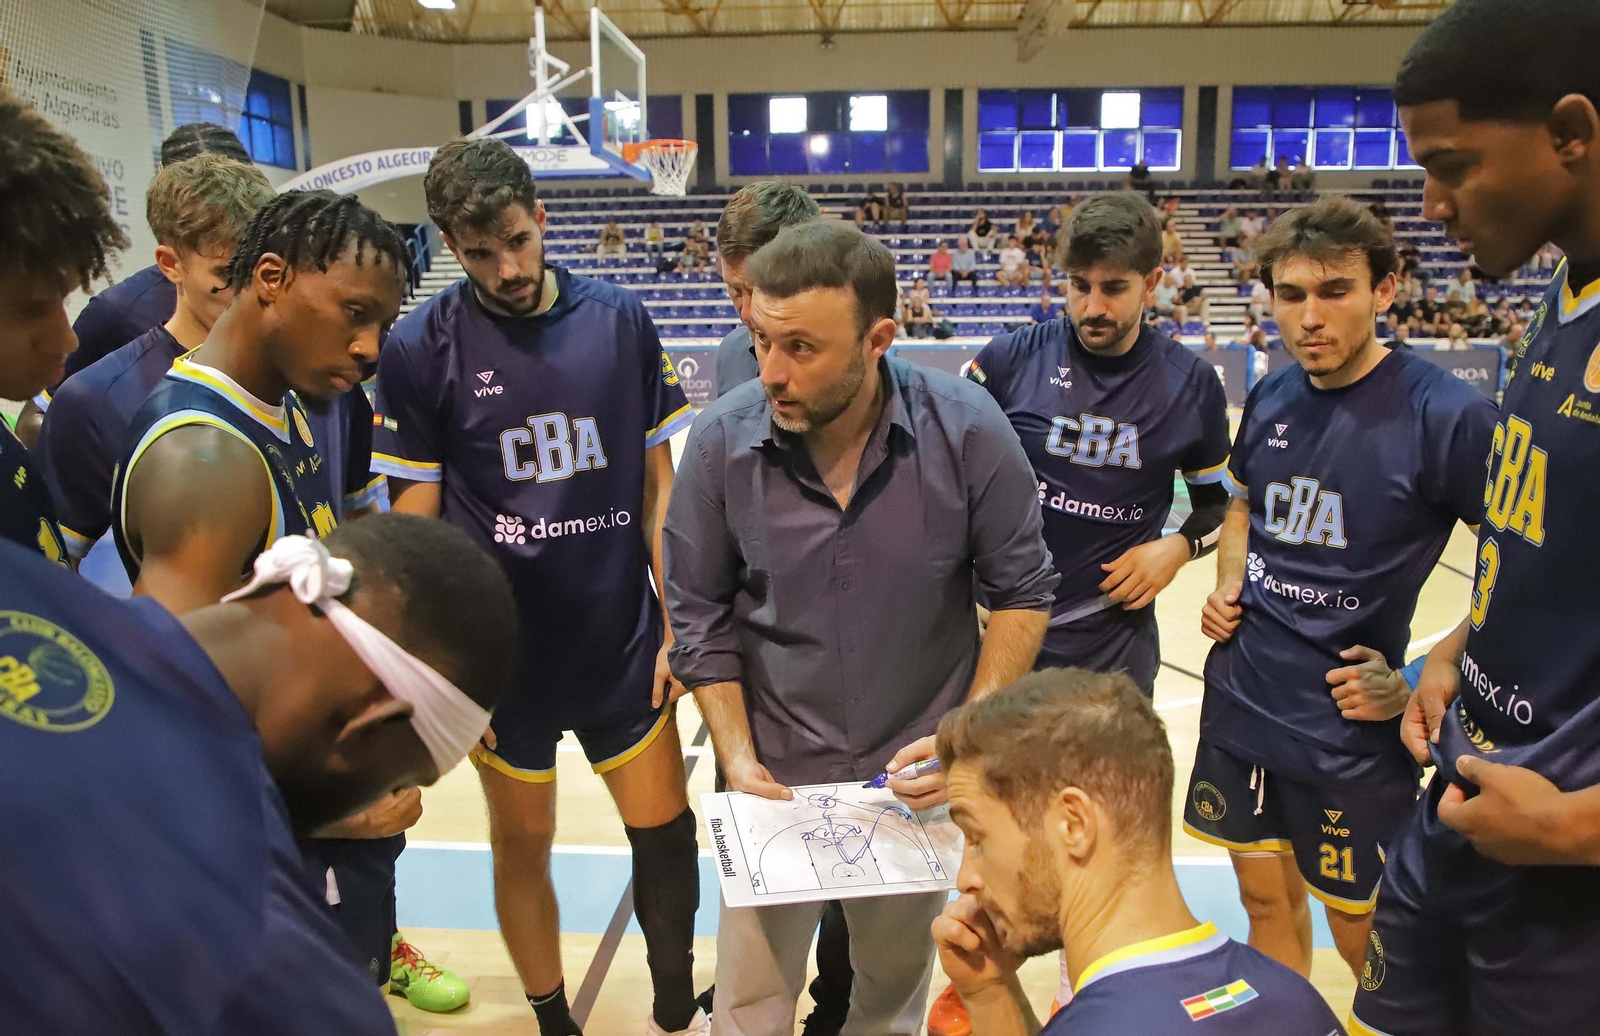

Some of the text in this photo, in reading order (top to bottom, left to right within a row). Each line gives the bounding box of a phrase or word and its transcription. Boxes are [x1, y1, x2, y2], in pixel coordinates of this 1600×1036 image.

[44, 92, 120, 129] Algeciras
[298, 160, 372, 192] ALONCESTO
[1050, 376, 1073, 389] vive
[1452, 368, 1489, 381] ROA
[1531, 361, 1555, 381] vive
[474, 385, 504, 398] vive
[500, 411, 608, 484] CBA
[1045, 412, 1143, 470] CBA
[1267, 437, 1289, 449] vive
[1484, 413, 1549, 548] CBA
[530, 507, 631, 540] damex.io
[1050, 492, 1144, 521] damex.io
[1264, 475, 1348, 549] CBA
[1263, 574, 1360, 611] damex.io
[1470, 535, 1501, 632] 3
[710, 817, 737, 878] fiba.basketball
[1321, 824, 1350, 838] vive
[1319, 842, 1356, 883] 21
